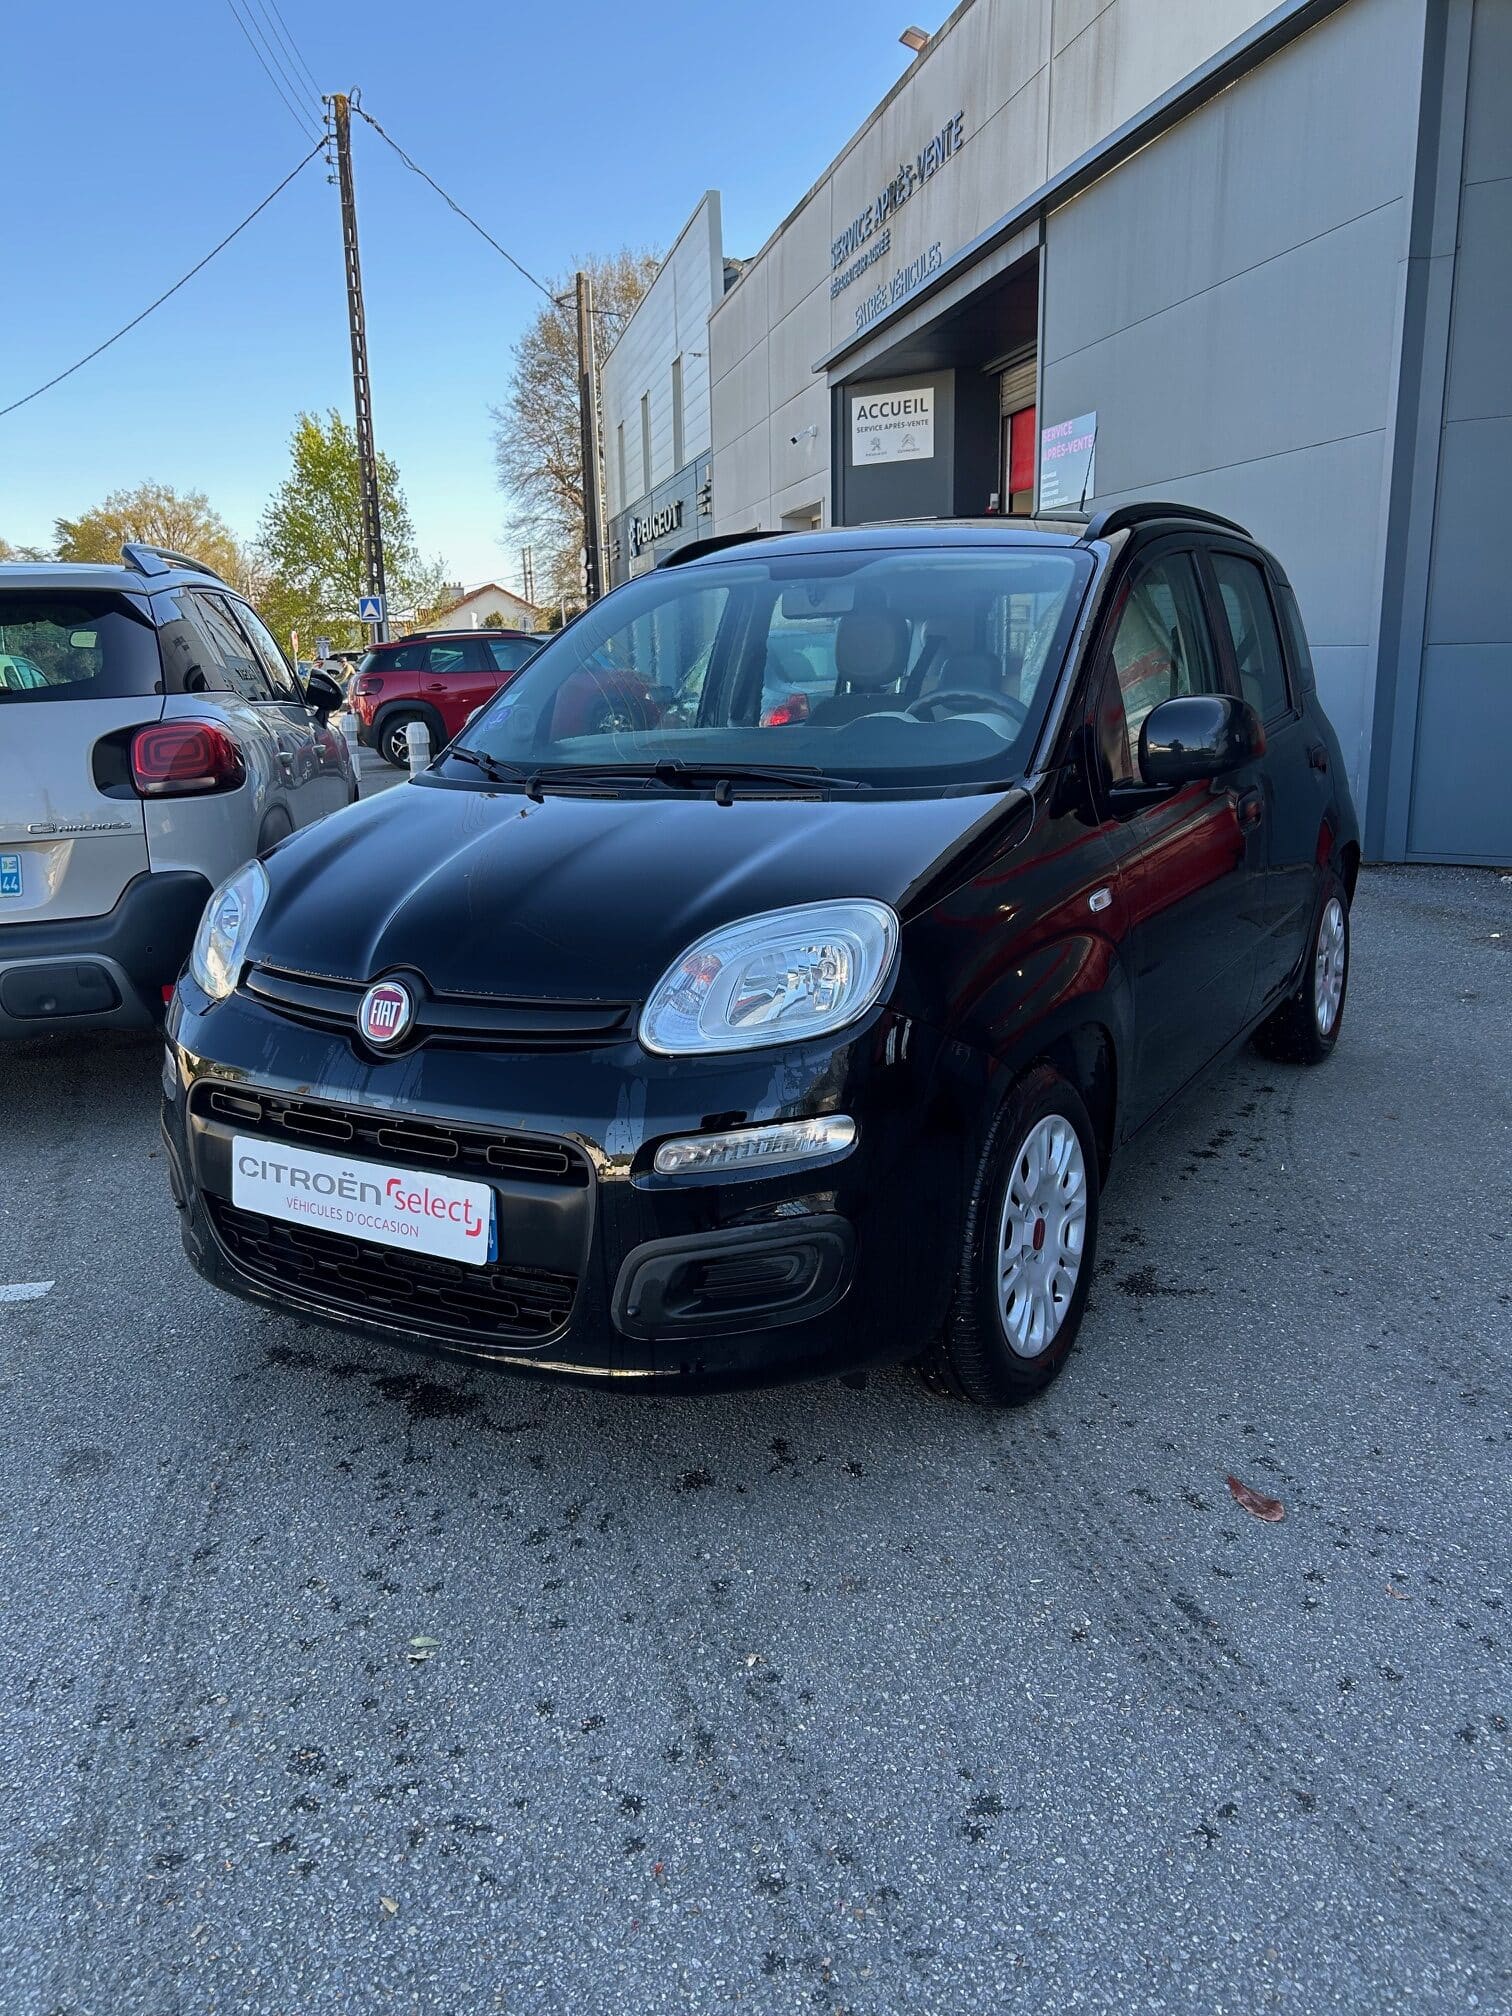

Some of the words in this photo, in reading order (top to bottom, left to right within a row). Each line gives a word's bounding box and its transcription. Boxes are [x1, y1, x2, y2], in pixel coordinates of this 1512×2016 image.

[830, 204, 873, 270] SERVICE
[855, 284, 888, 332] ENTRÉE
[889, 241, 942, 304] VÉHICULES
[856, 397, 929, 421] ACCUEIL
[856, 425, 883, 434] SERVICE
[1042, 421, 1073, 443] SERVICE
[636, 500, 683, 546] PEUGEOT
[2, 876, 19, 891] 44
[370, 999, 401, 1027] FIAT
[238, 1155, 382, 1206] CITROËN
[393, 1187, 474, 1225] select
[286, 1194, 343, 1221] VÉHICULES
[345, 1209, 420, 1238] D'OCCASION
